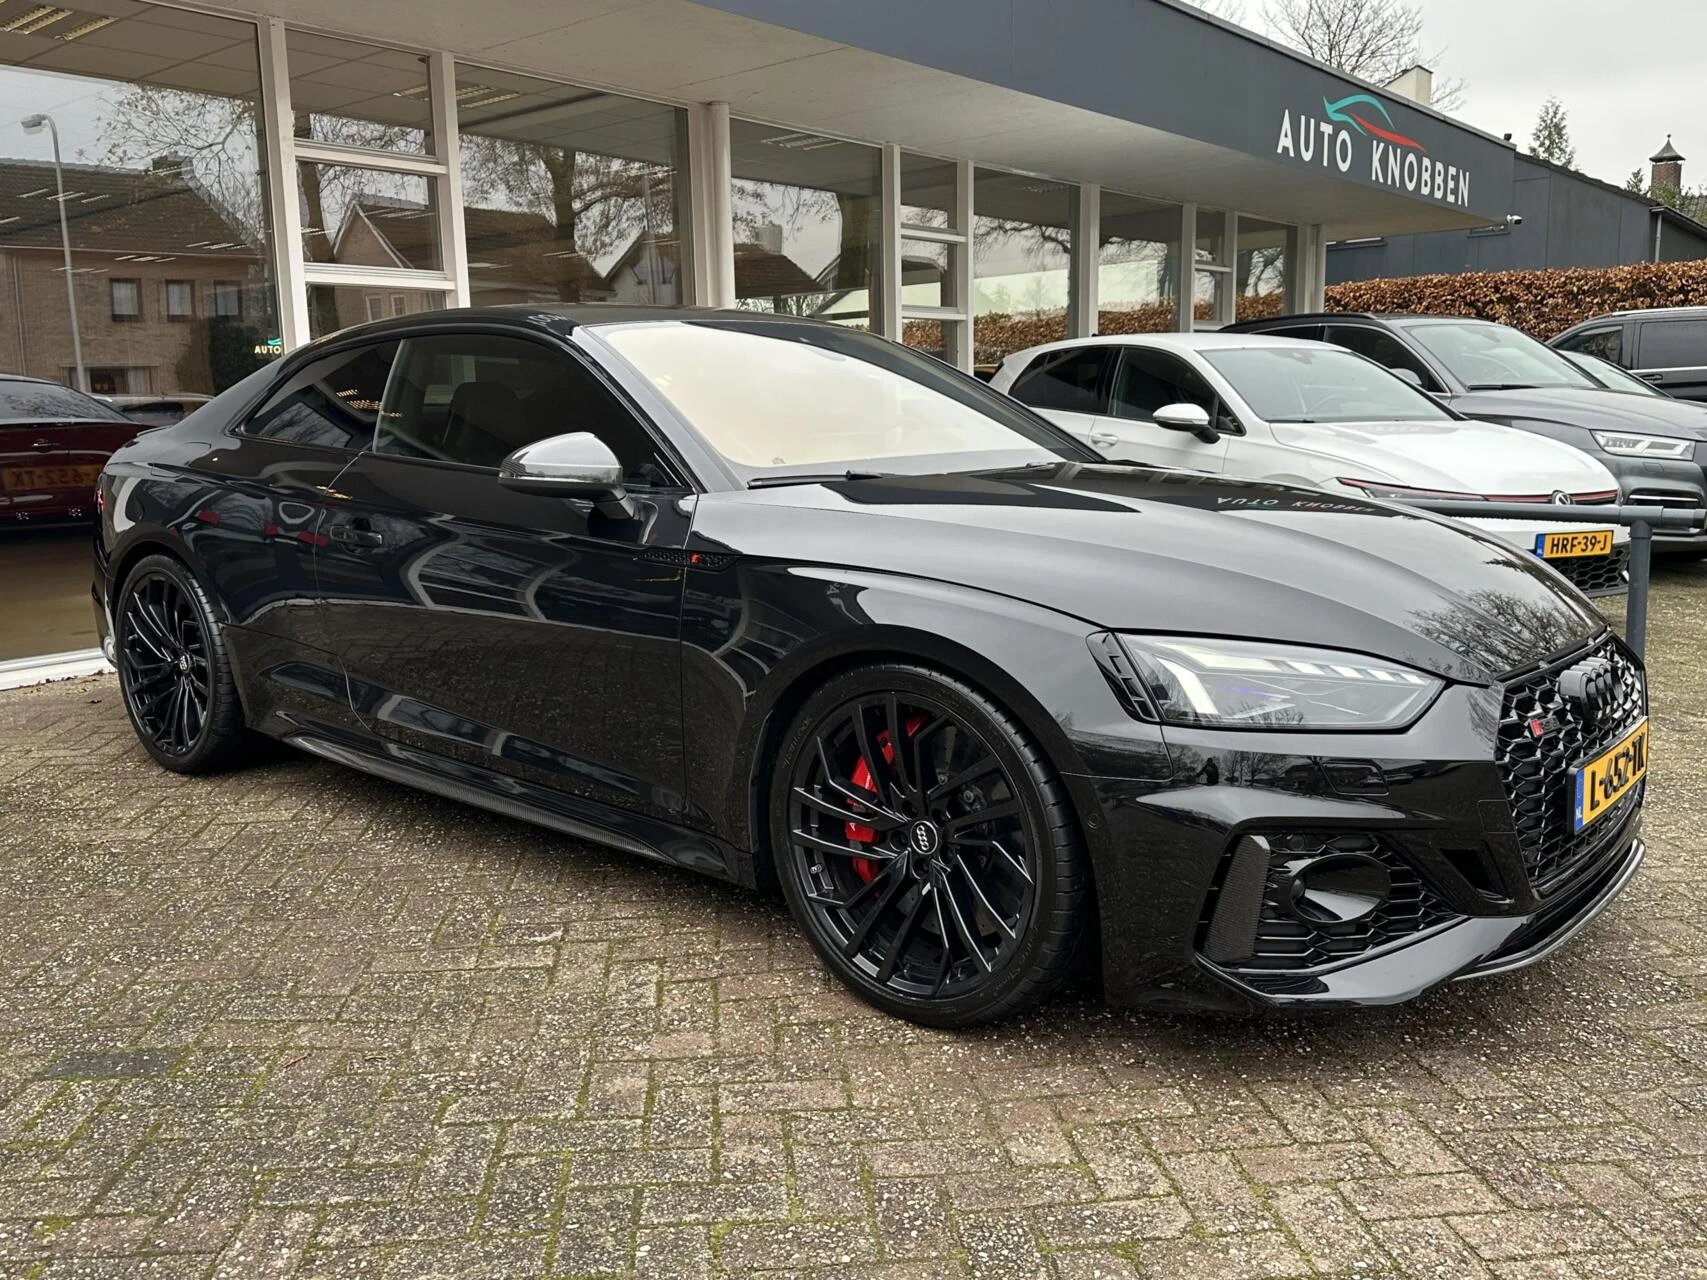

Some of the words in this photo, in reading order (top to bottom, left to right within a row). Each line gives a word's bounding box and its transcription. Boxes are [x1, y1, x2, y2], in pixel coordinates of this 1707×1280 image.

[1277, 108, 1352, 173] AUTO
[1371, 139, 1470, 207] KNOBBEN
[254, 345, 281, 355] AUTO
[1550, 534, 1607, 554] HRF-39-J
[1590, 732, 1646, 811] L-652-TK
